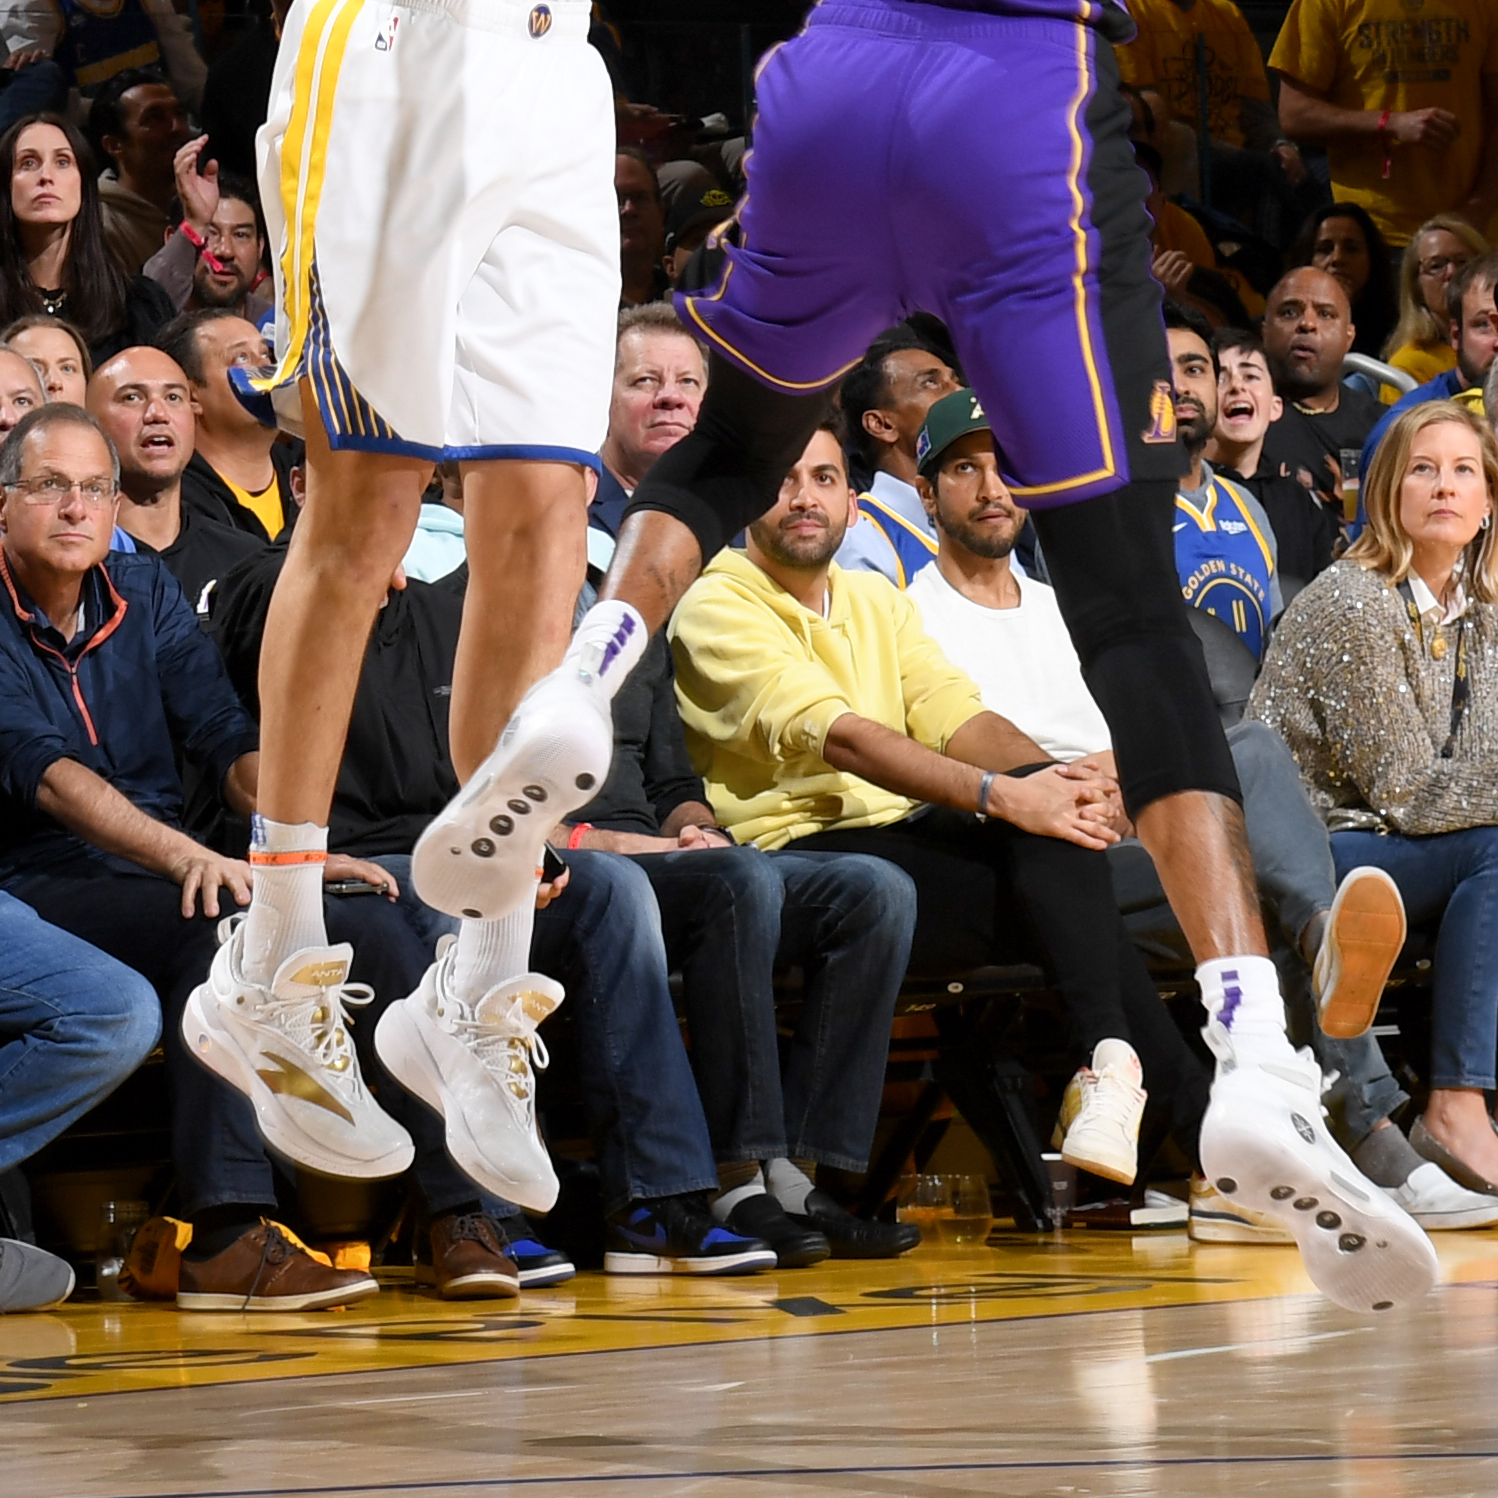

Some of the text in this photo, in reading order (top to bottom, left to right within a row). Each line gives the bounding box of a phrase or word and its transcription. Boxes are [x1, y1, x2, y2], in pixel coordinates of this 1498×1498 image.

[1358, 18, 1471, 49] STRENGTH
[1181, 559, 1266, 603] GOLDEN STATE
[1231, 599, 1248, 633] 11
[311, 968, 344, 979] ANTA
